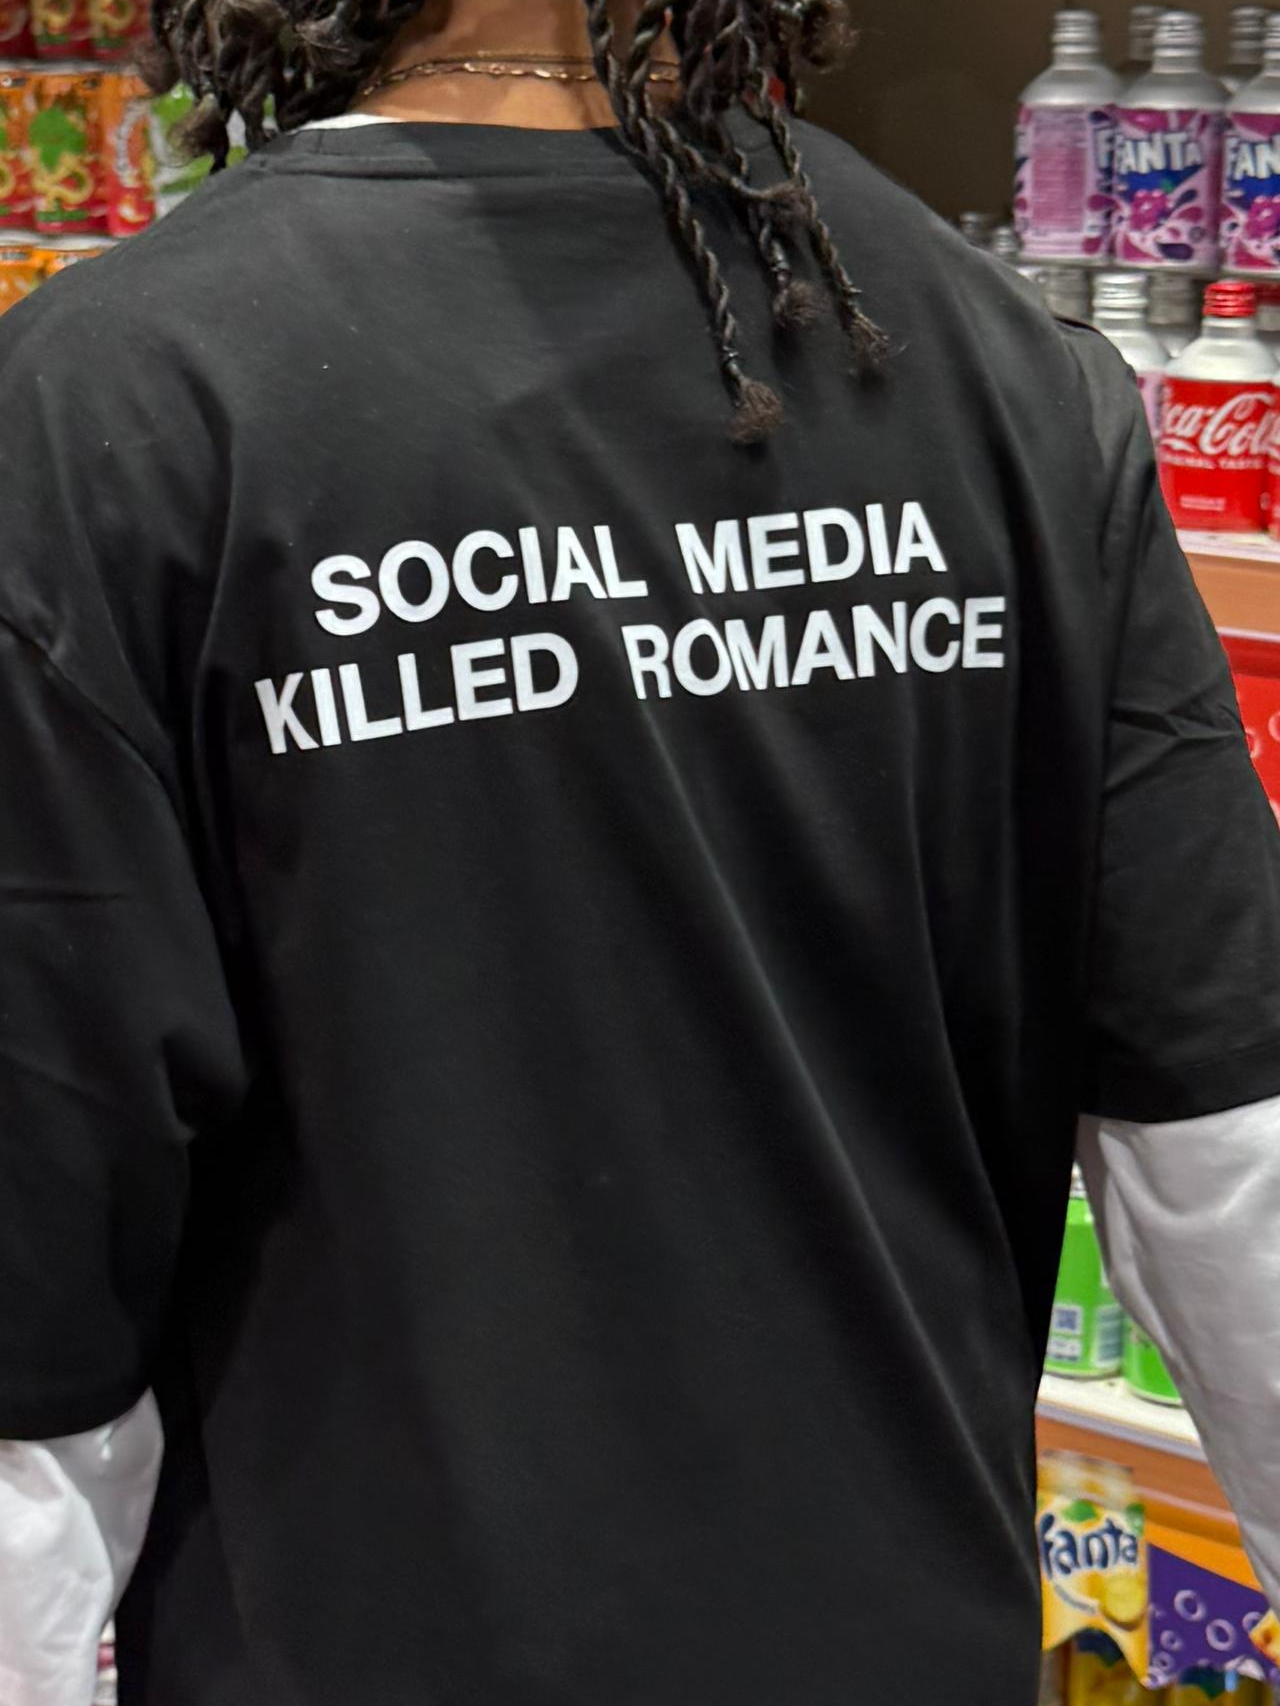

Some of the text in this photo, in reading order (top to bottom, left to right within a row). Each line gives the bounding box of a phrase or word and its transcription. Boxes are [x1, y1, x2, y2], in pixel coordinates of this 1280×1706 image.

[311, 500, 948, 637] SOCIAL MEDIA
[254, 596, 1008, 755] KILLED ROMANCE
[1037, 1506, 1141, 1578] Fanta
